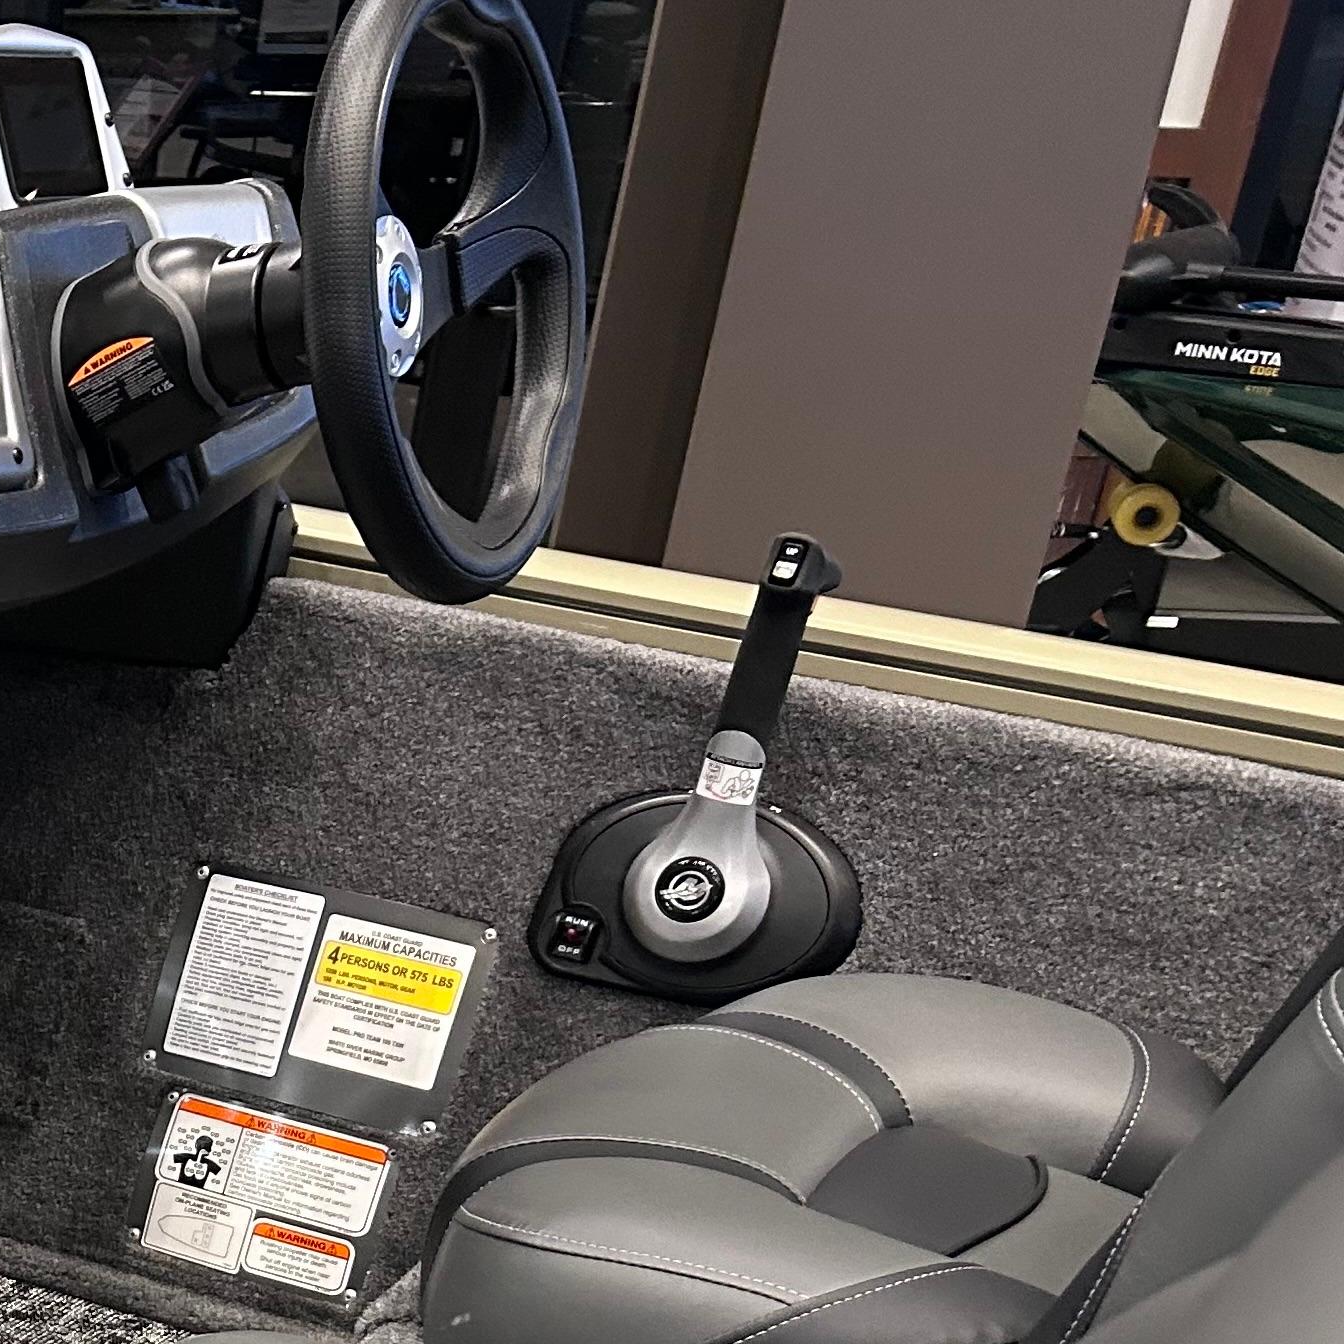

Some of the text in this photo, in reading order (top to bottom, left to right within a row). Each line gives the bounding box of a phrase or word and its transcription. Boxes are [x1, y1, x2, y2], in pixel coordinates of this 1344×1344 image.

[91, 342, 133, 370] WARNING
[1175, 341, 1281, 367] MINN KOTA
[1250, 365, 1280, 377] EDGE
[565, 915, 589, 928] RUN
[383, 933, 401, 941] COAST
[403, 938, 422, 946] GUARD
[339, 931, 457, 966] MAXIMUM CAPACITIES
[558, 944, 581, 956] OFF
[328, 946, 453, 987] 4 PERSONS OR 575 LBS
[313, 997, 332, 1005] SAFETY
[334, 1002, 366, 1014] STANDARDS
[353, 1014, 393, 1028] CERTIFICATION
[400, 1010, 419, 1019] COAST
[257, 1120, 306, 1140] WARNING
[184, 1206, 216, 1220] LOCATIONS
[276, 1229, 325, 1250] WARNING
